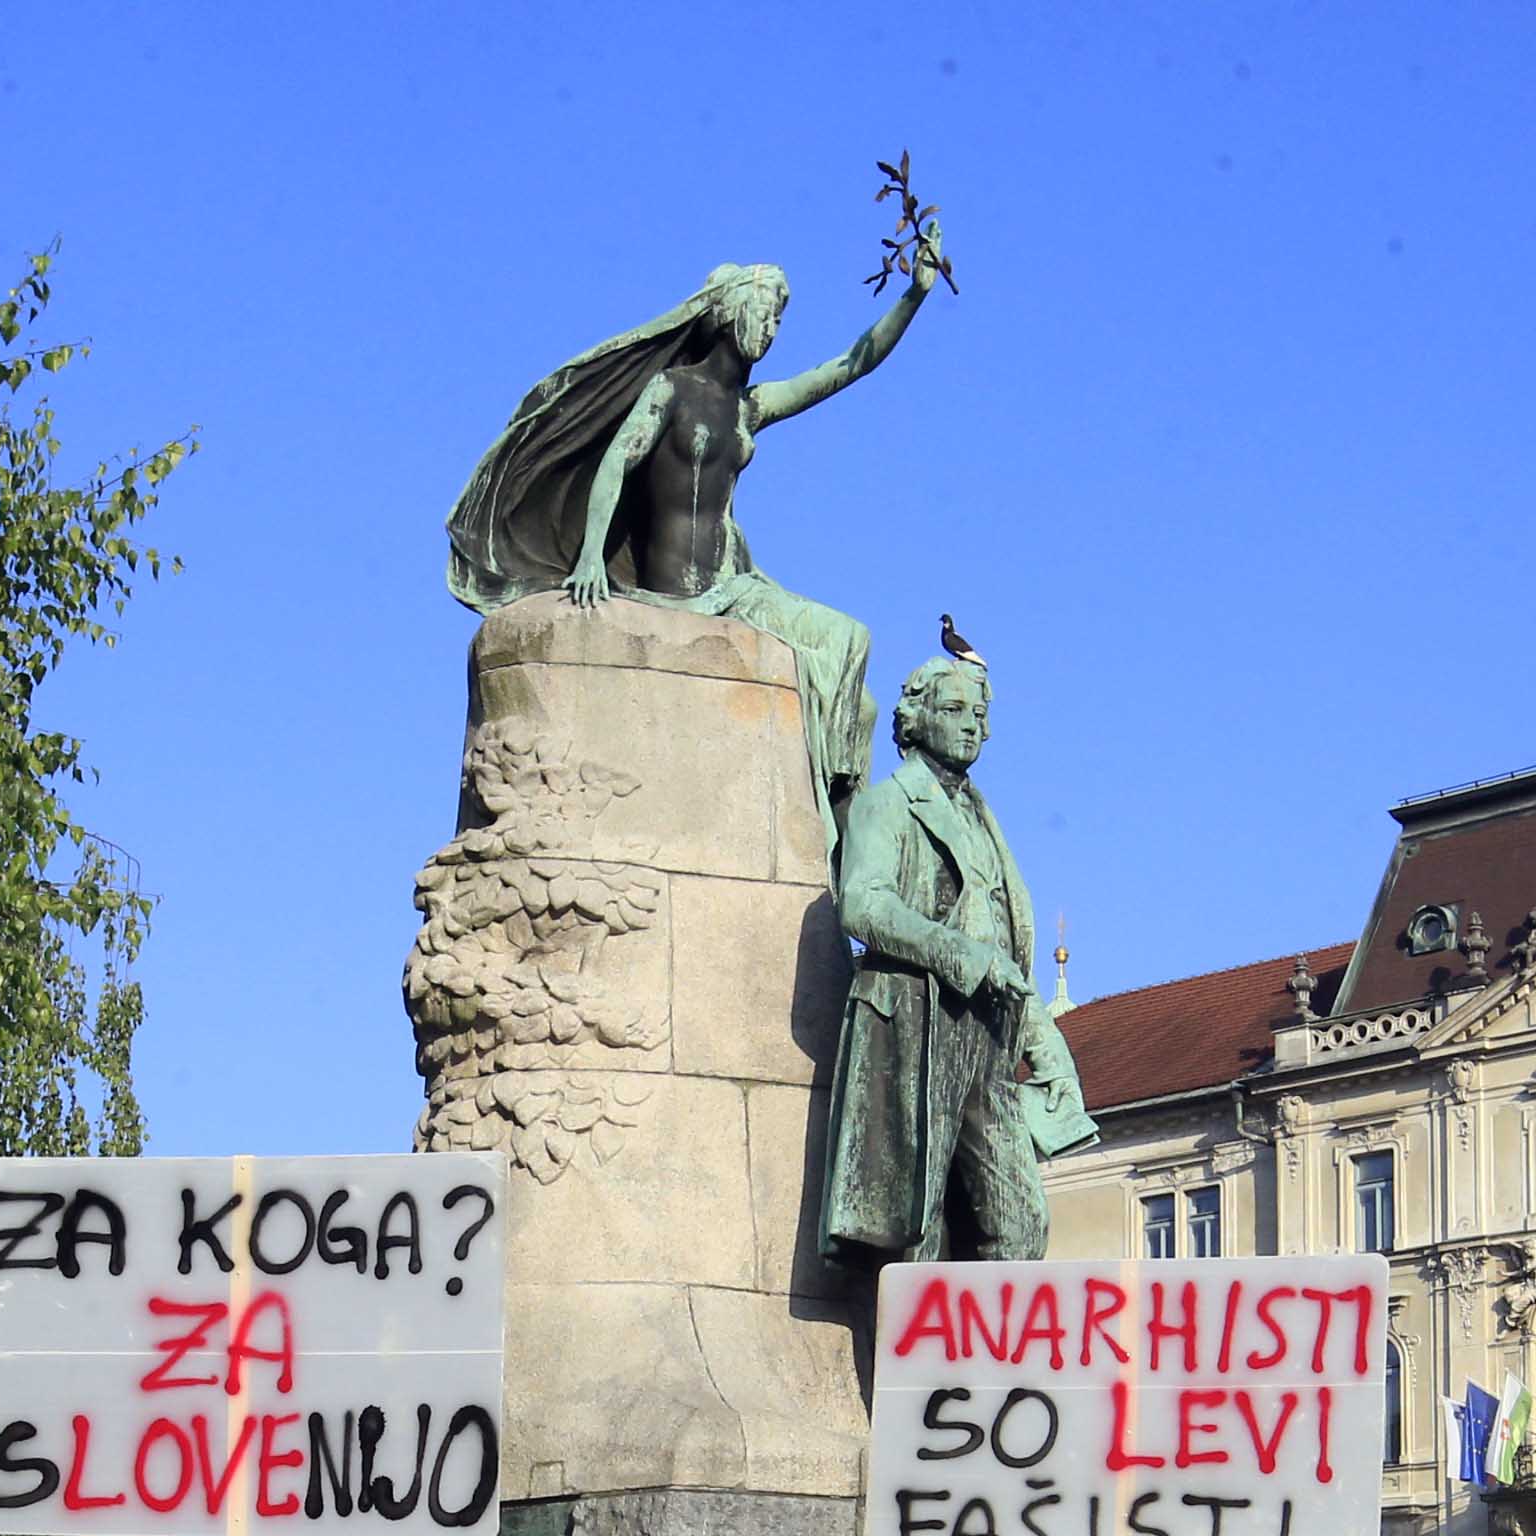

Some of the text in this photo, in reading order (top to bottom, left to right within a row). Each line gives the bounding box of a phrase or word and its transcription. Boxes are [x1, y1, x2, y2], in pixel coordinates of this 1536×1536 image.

[177, 1184, 495, 1297] KOGA?
[138, 1290, 295, 1396] ZA
[893, 1277, 1373, 1376] ANARHISTI
[916, 1382, 1334, 1484] SO LEVI
